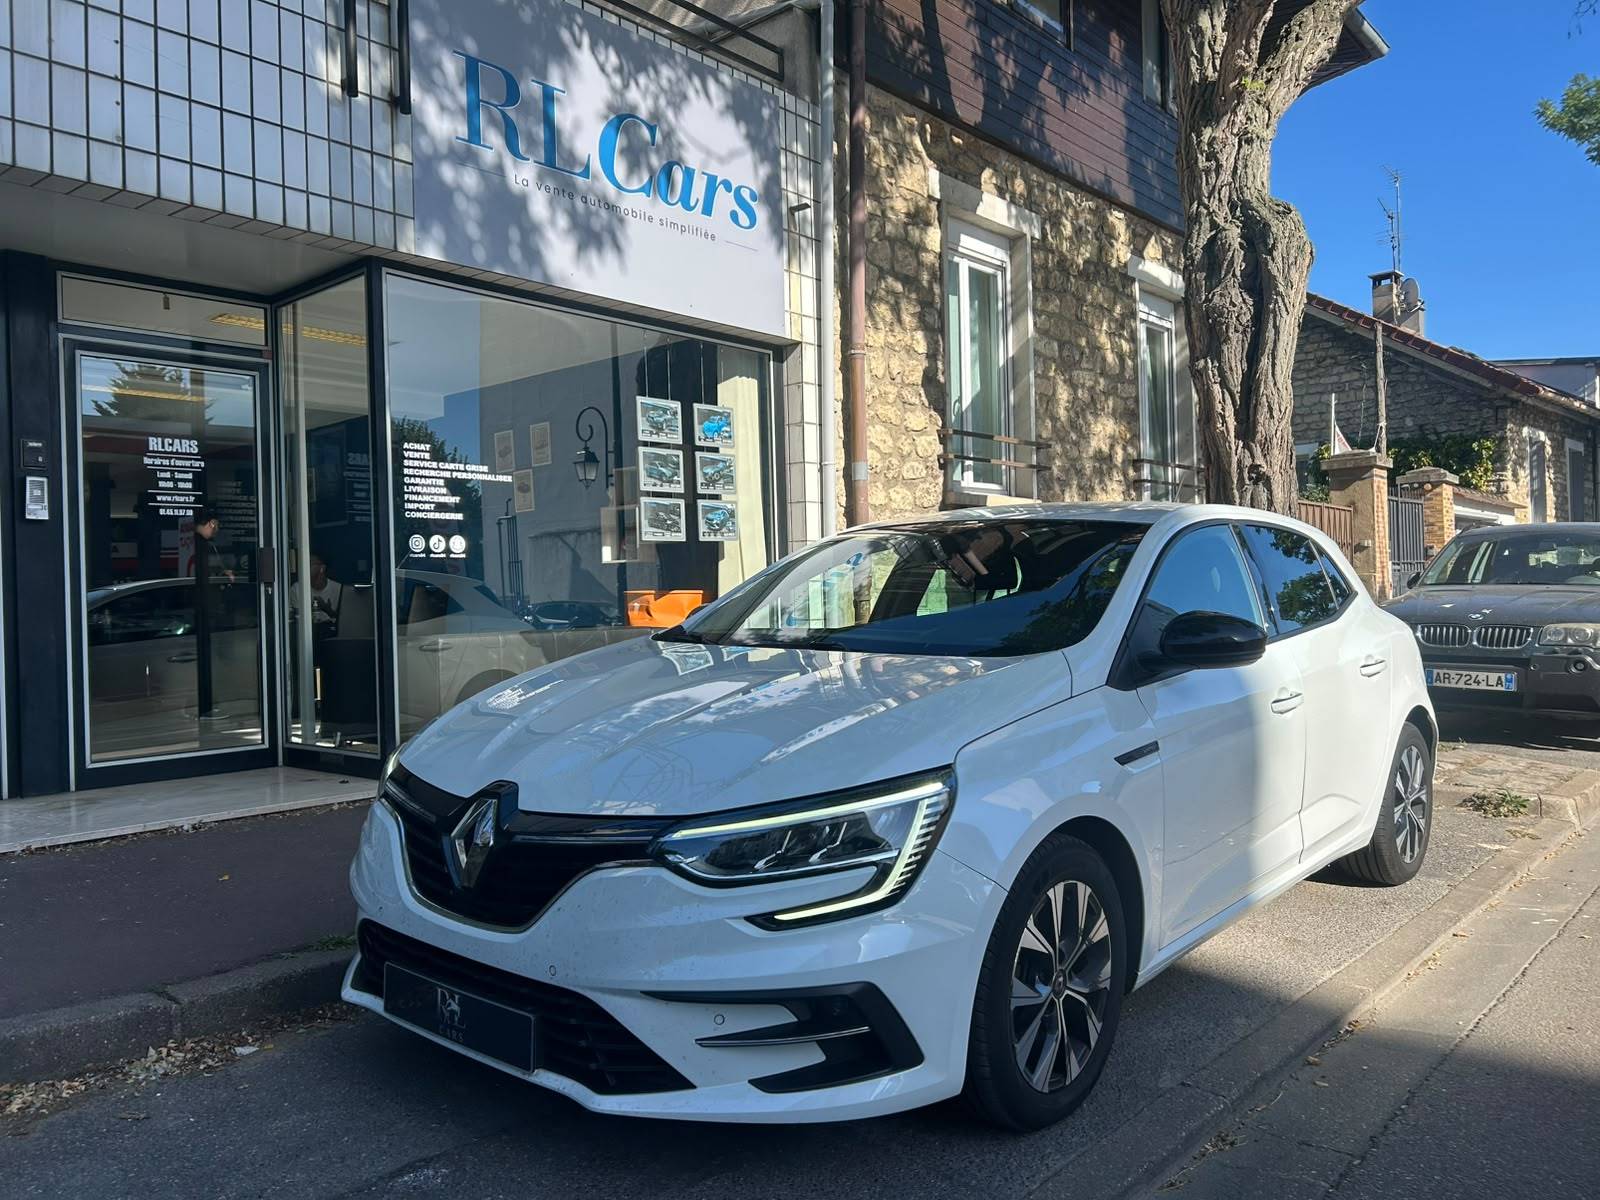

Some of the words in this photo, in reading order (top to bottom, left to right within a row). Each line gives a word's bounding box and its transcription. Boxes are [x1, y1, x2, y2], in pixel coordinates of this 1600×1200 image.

[514, 174, 529, 188] La
[535, 182, 575, 201] vente
[581, 193, 654, 223] automobile
[658, 216, 717, 242] simplifiée
[148, 436, 199, 454] RLCARS
[403, 442, 431, 451] ACHAT
[403, 451, 430, 460] VENTE
[403, 460, 438, 469] SERVICE
[439, 463, 465, 471] CARTE
[466, 464, 489, 472] GRISE
[403, 468, 451, 478] RECHERCHE
[404, 477, 445, 486] GARANTIE
[404, 486, 447, 495] LIVRAISON
[404, 494, 461, 503] FINANCEMENT
[404, 503, 436, 511] IMPORT
[405, 511, 464, 520] CONCIERGERIE
[1434, 672, 1504, 688] AR-724-LA
